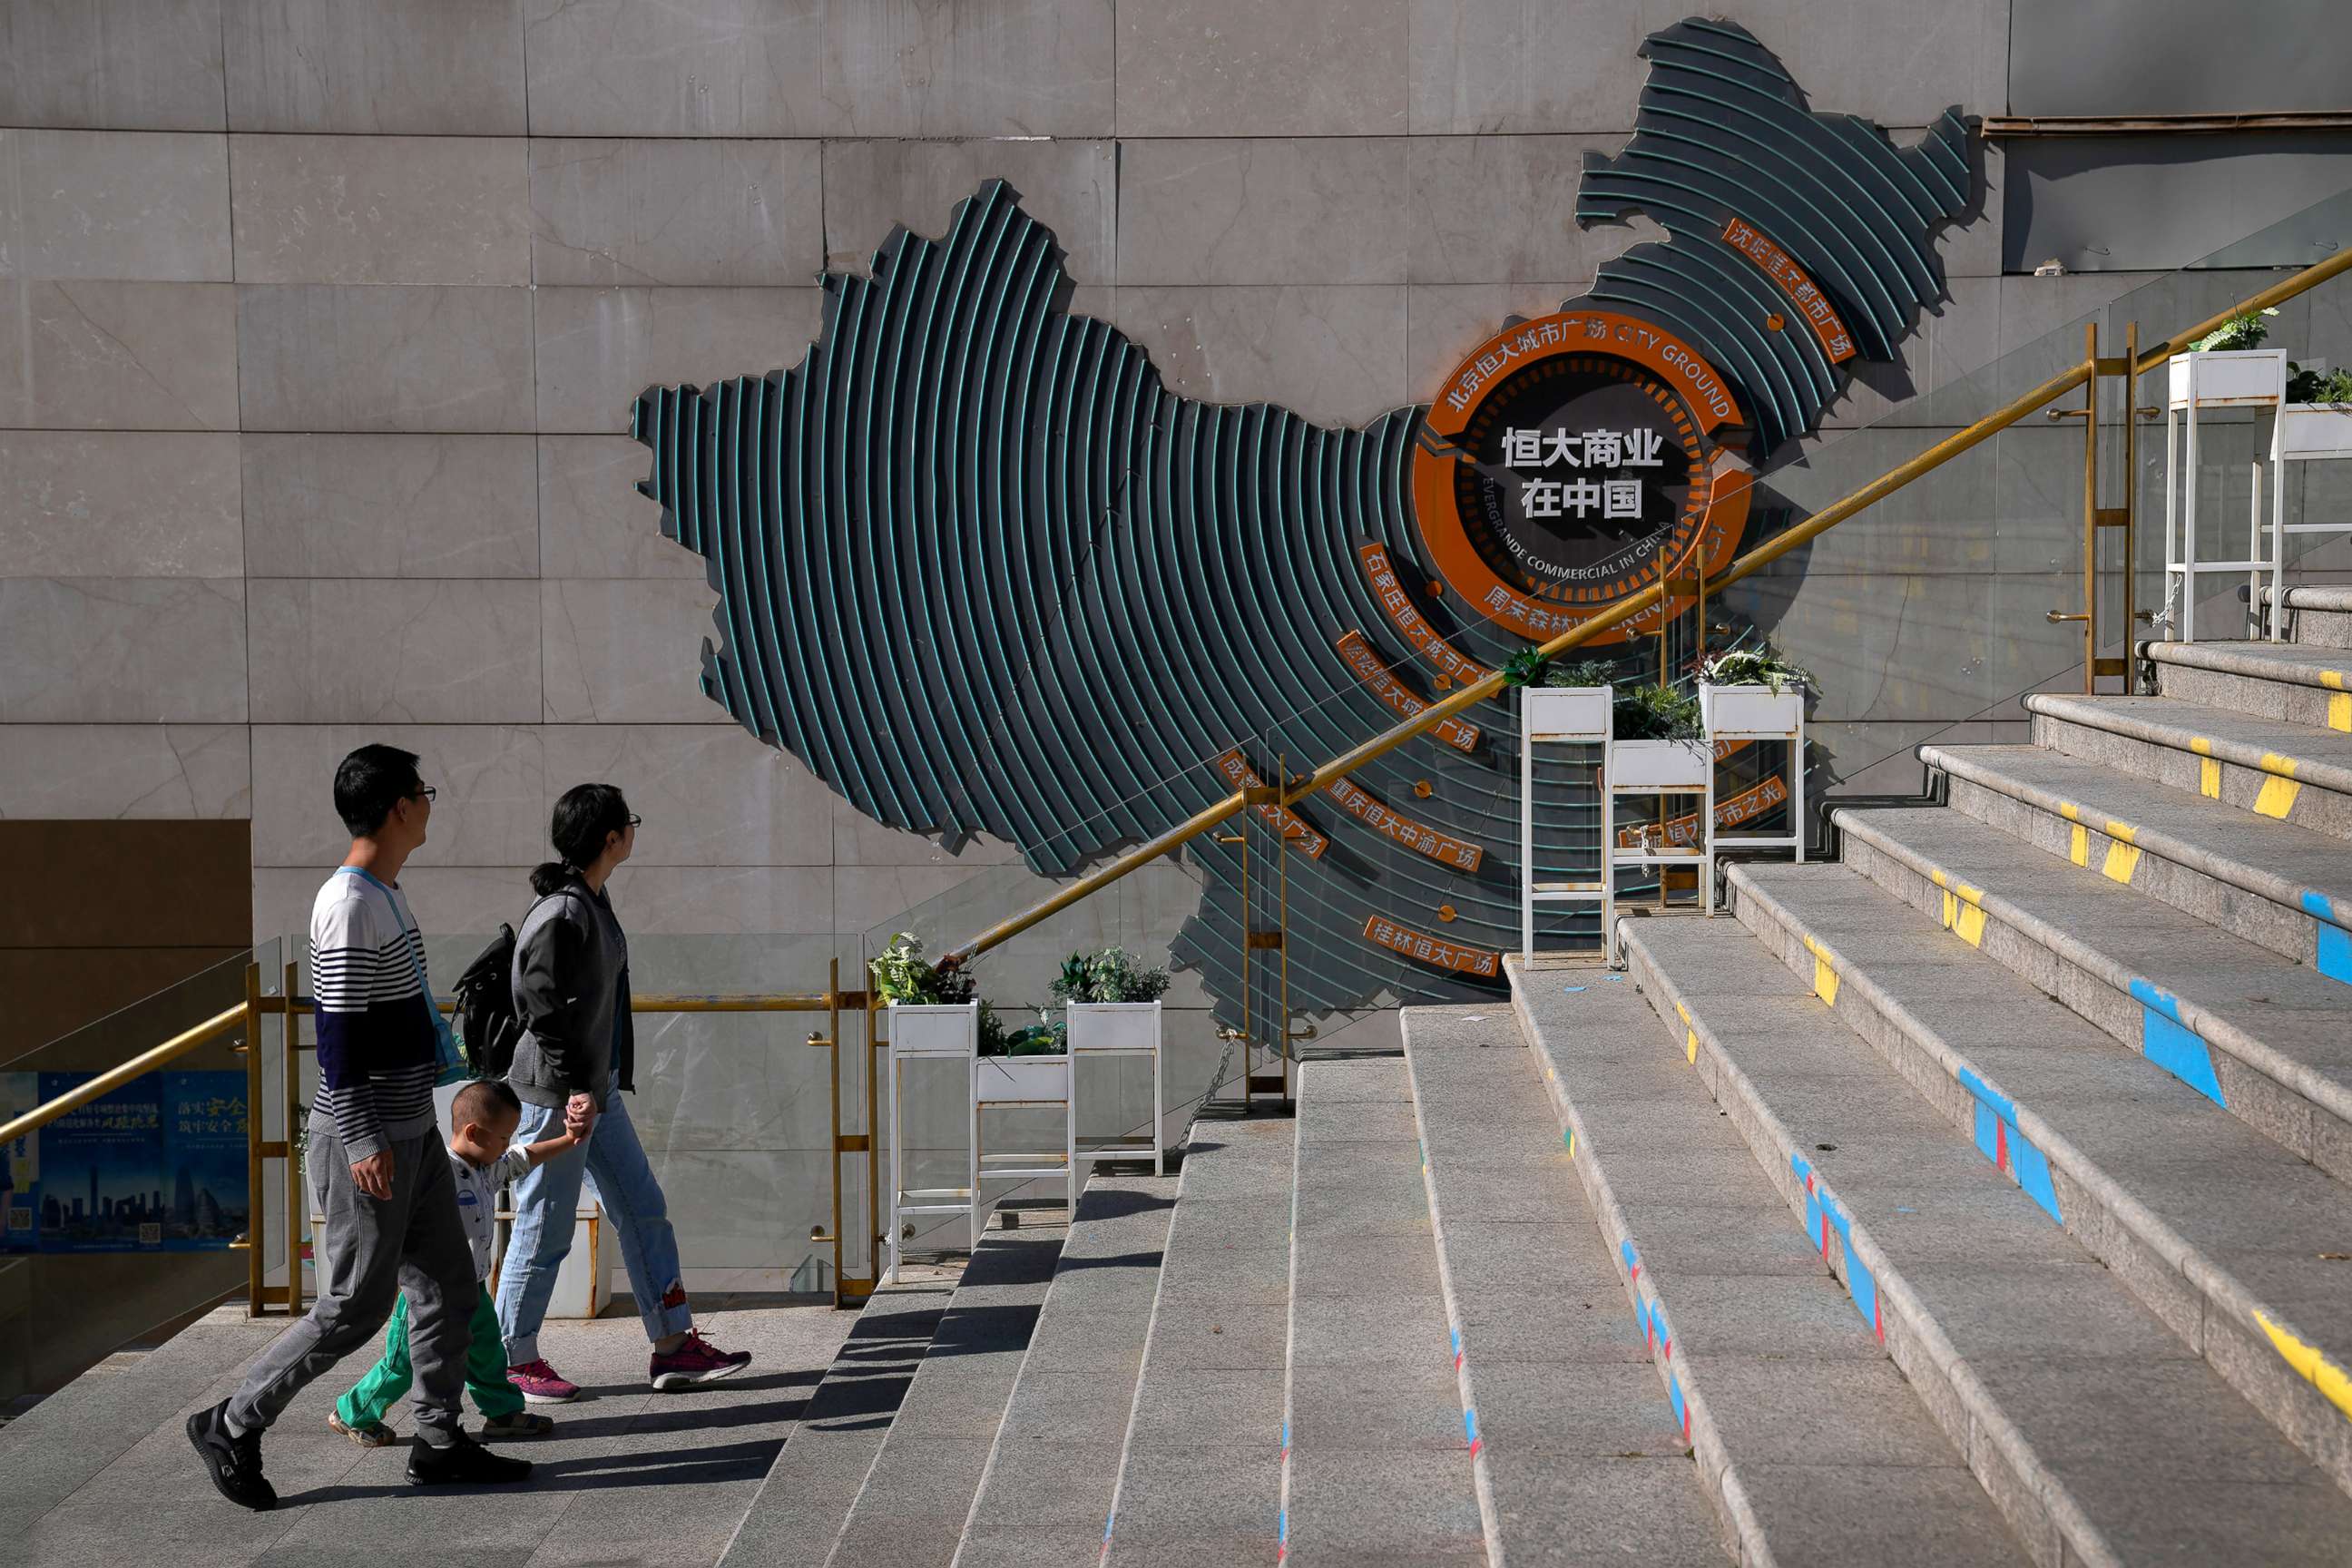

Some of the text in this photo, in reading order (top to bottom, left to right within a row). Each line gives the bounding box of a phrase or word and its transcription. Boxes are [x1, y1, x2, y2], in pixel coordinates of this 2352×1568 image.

[1446, 318, 1608, 413] 北京恒大城市广场
[1614, 322, 1730, 418] CITY GROUND
[1501, 426, 1663, 468] 恒大商业
[1483, 477, 1527, 560] EVERGRANDE
[1526, 555, 1618, 581] COMMERCIAL
[1619, 554, 1636, 571] IN
[1636, 520, 1671, 559] CHINA
[1522, 478, 1642, 518] 在中国
[1329, 776, 1476, 868] 重庆恒大中渝广场
[1373, 921, 1493, 975] 桂林恒大广场
